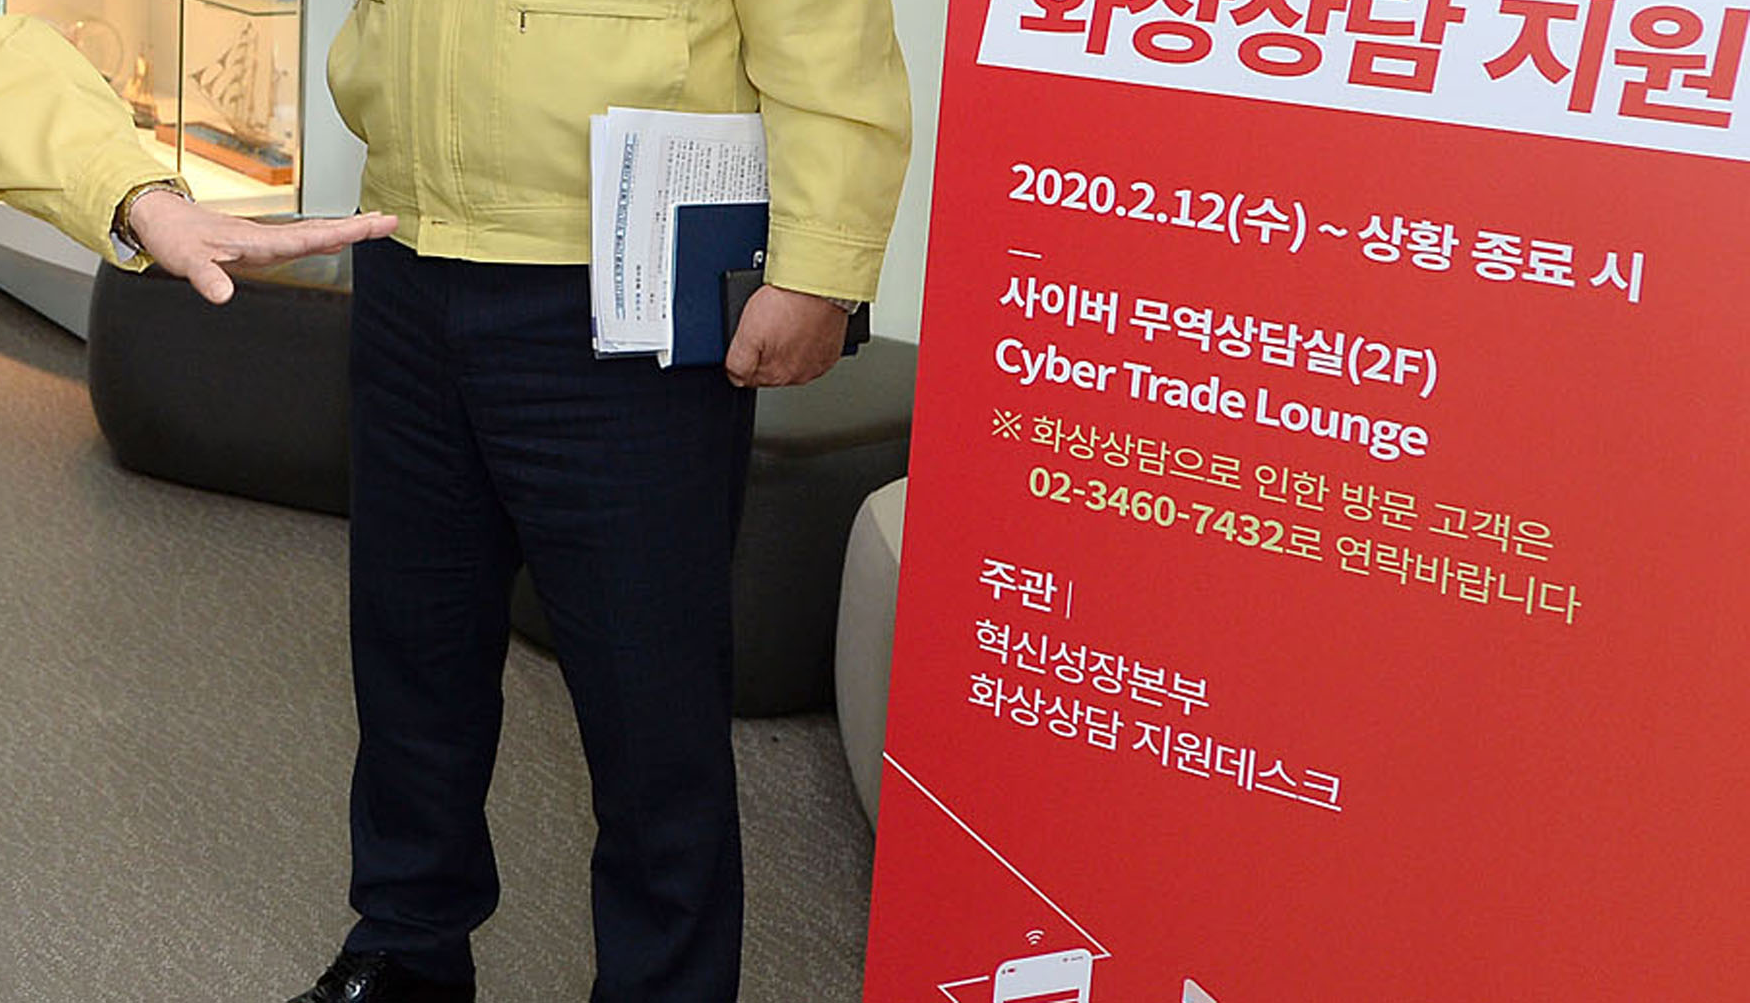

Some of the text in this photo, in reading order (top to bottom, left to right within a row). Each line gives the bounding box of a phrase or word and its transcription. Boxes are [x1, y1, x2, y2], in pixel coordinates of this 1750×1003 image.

[1010, 164, 1306, 252] 2020.2.12(수)
[1358, 216, 1459, 270] 상황
[1472, 231, 1575, 287] 종료
[1590, 252, 1643, 303] 시
[996, 339, 1428, 460] Cyber Trade Lounge
[1000, 278, 1436, 398] 사이버 무역상담실(2F)
[1030, 468, 1581, 624] 02-3460-7432로 연락바랍니다
[1031, 416, 1241, 489] 화상상담으로
[1256, 466, 1330, 511] 인한
[1342, 483, 1418, 530] 방문
[1429, 504, 1553, 561] 고객은
[980, 559, 1057, 612] 주관
[976, 620, 1209, 715] 혁신성장본부
[969, 673, 1341, 811] 화상상담 지원데스크
